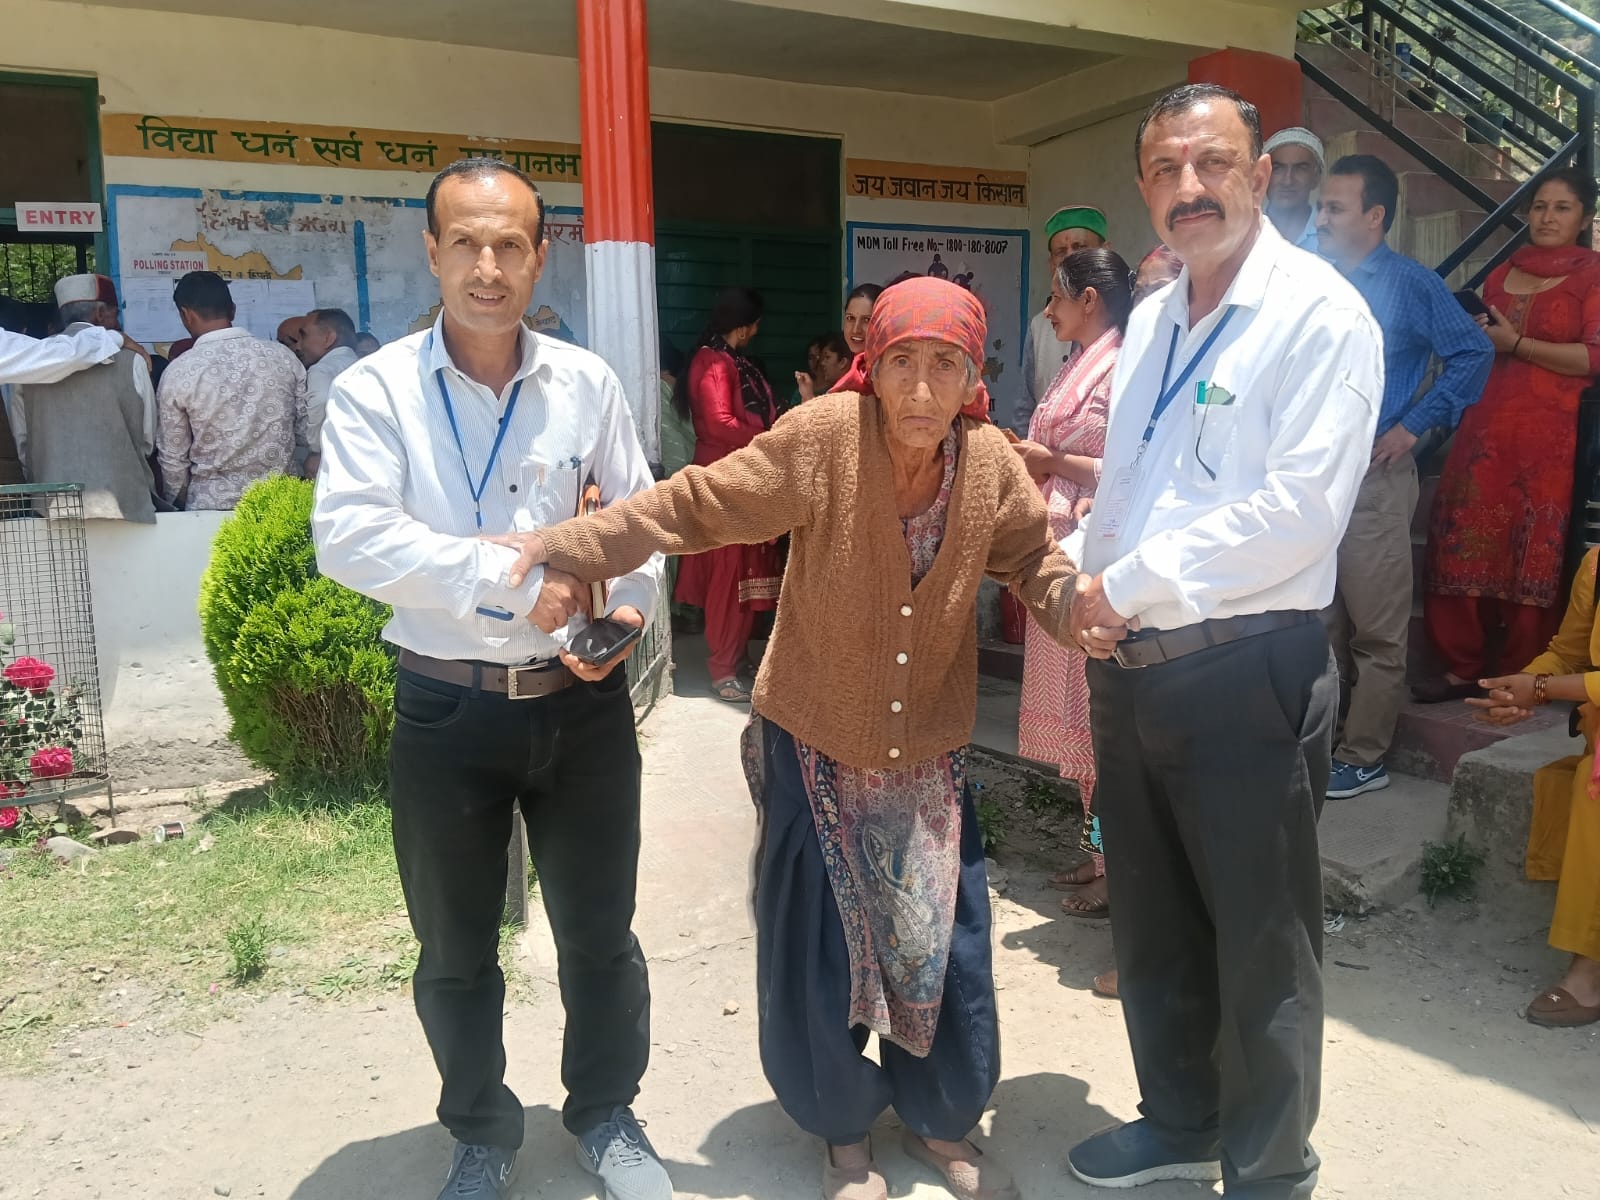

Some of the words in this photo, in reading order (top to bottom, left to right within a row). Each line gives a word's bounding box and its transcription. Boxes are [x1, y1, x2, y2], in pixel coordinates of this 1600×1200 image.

[135, 115, 218, 154] विद्या
[311, 131, 364, 166] सर्व
[852, 174, 885, 196] जय
[887, 177, 938, 199] जवान
[938, 180, 971, 201] जय
[974, 174, 1025, 206] किसान
[25, 209, 96, 225] ENTRY
[857, 236, 880, 250] MDM
[883, 237, 898, 251] Toll
[902, 237, 924, 252] Free
[946, 239, 1008, 254] 1800-180-8007
[134, 260, 168, 270] POLLING
[169, 260, 204, 270] STATION
